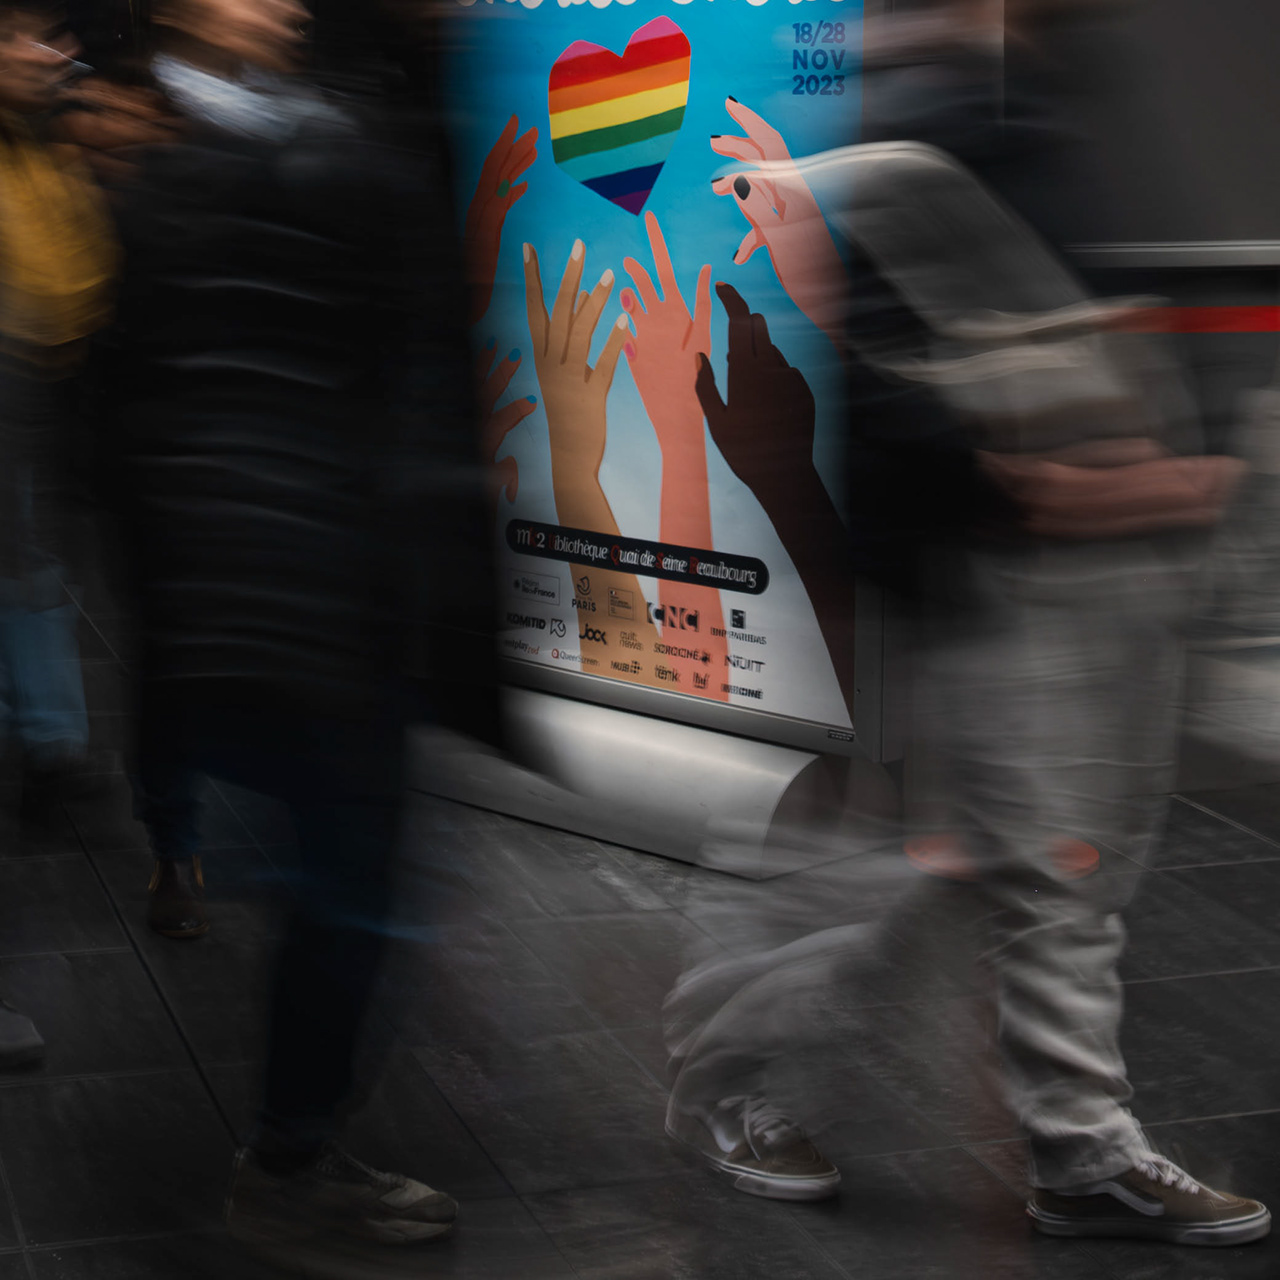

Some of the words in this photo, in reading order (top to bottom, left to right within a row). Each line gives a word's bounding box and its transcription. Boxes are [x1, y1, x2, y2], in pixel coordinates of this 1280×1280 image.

[792, 20, 846, 47] 18/28
[792, 48, 846, 71] NOV
[792, 74, 845, 96] 2023
[571, 598, 597, 613] PARIS
[647, 602, 699, 632] CNC
